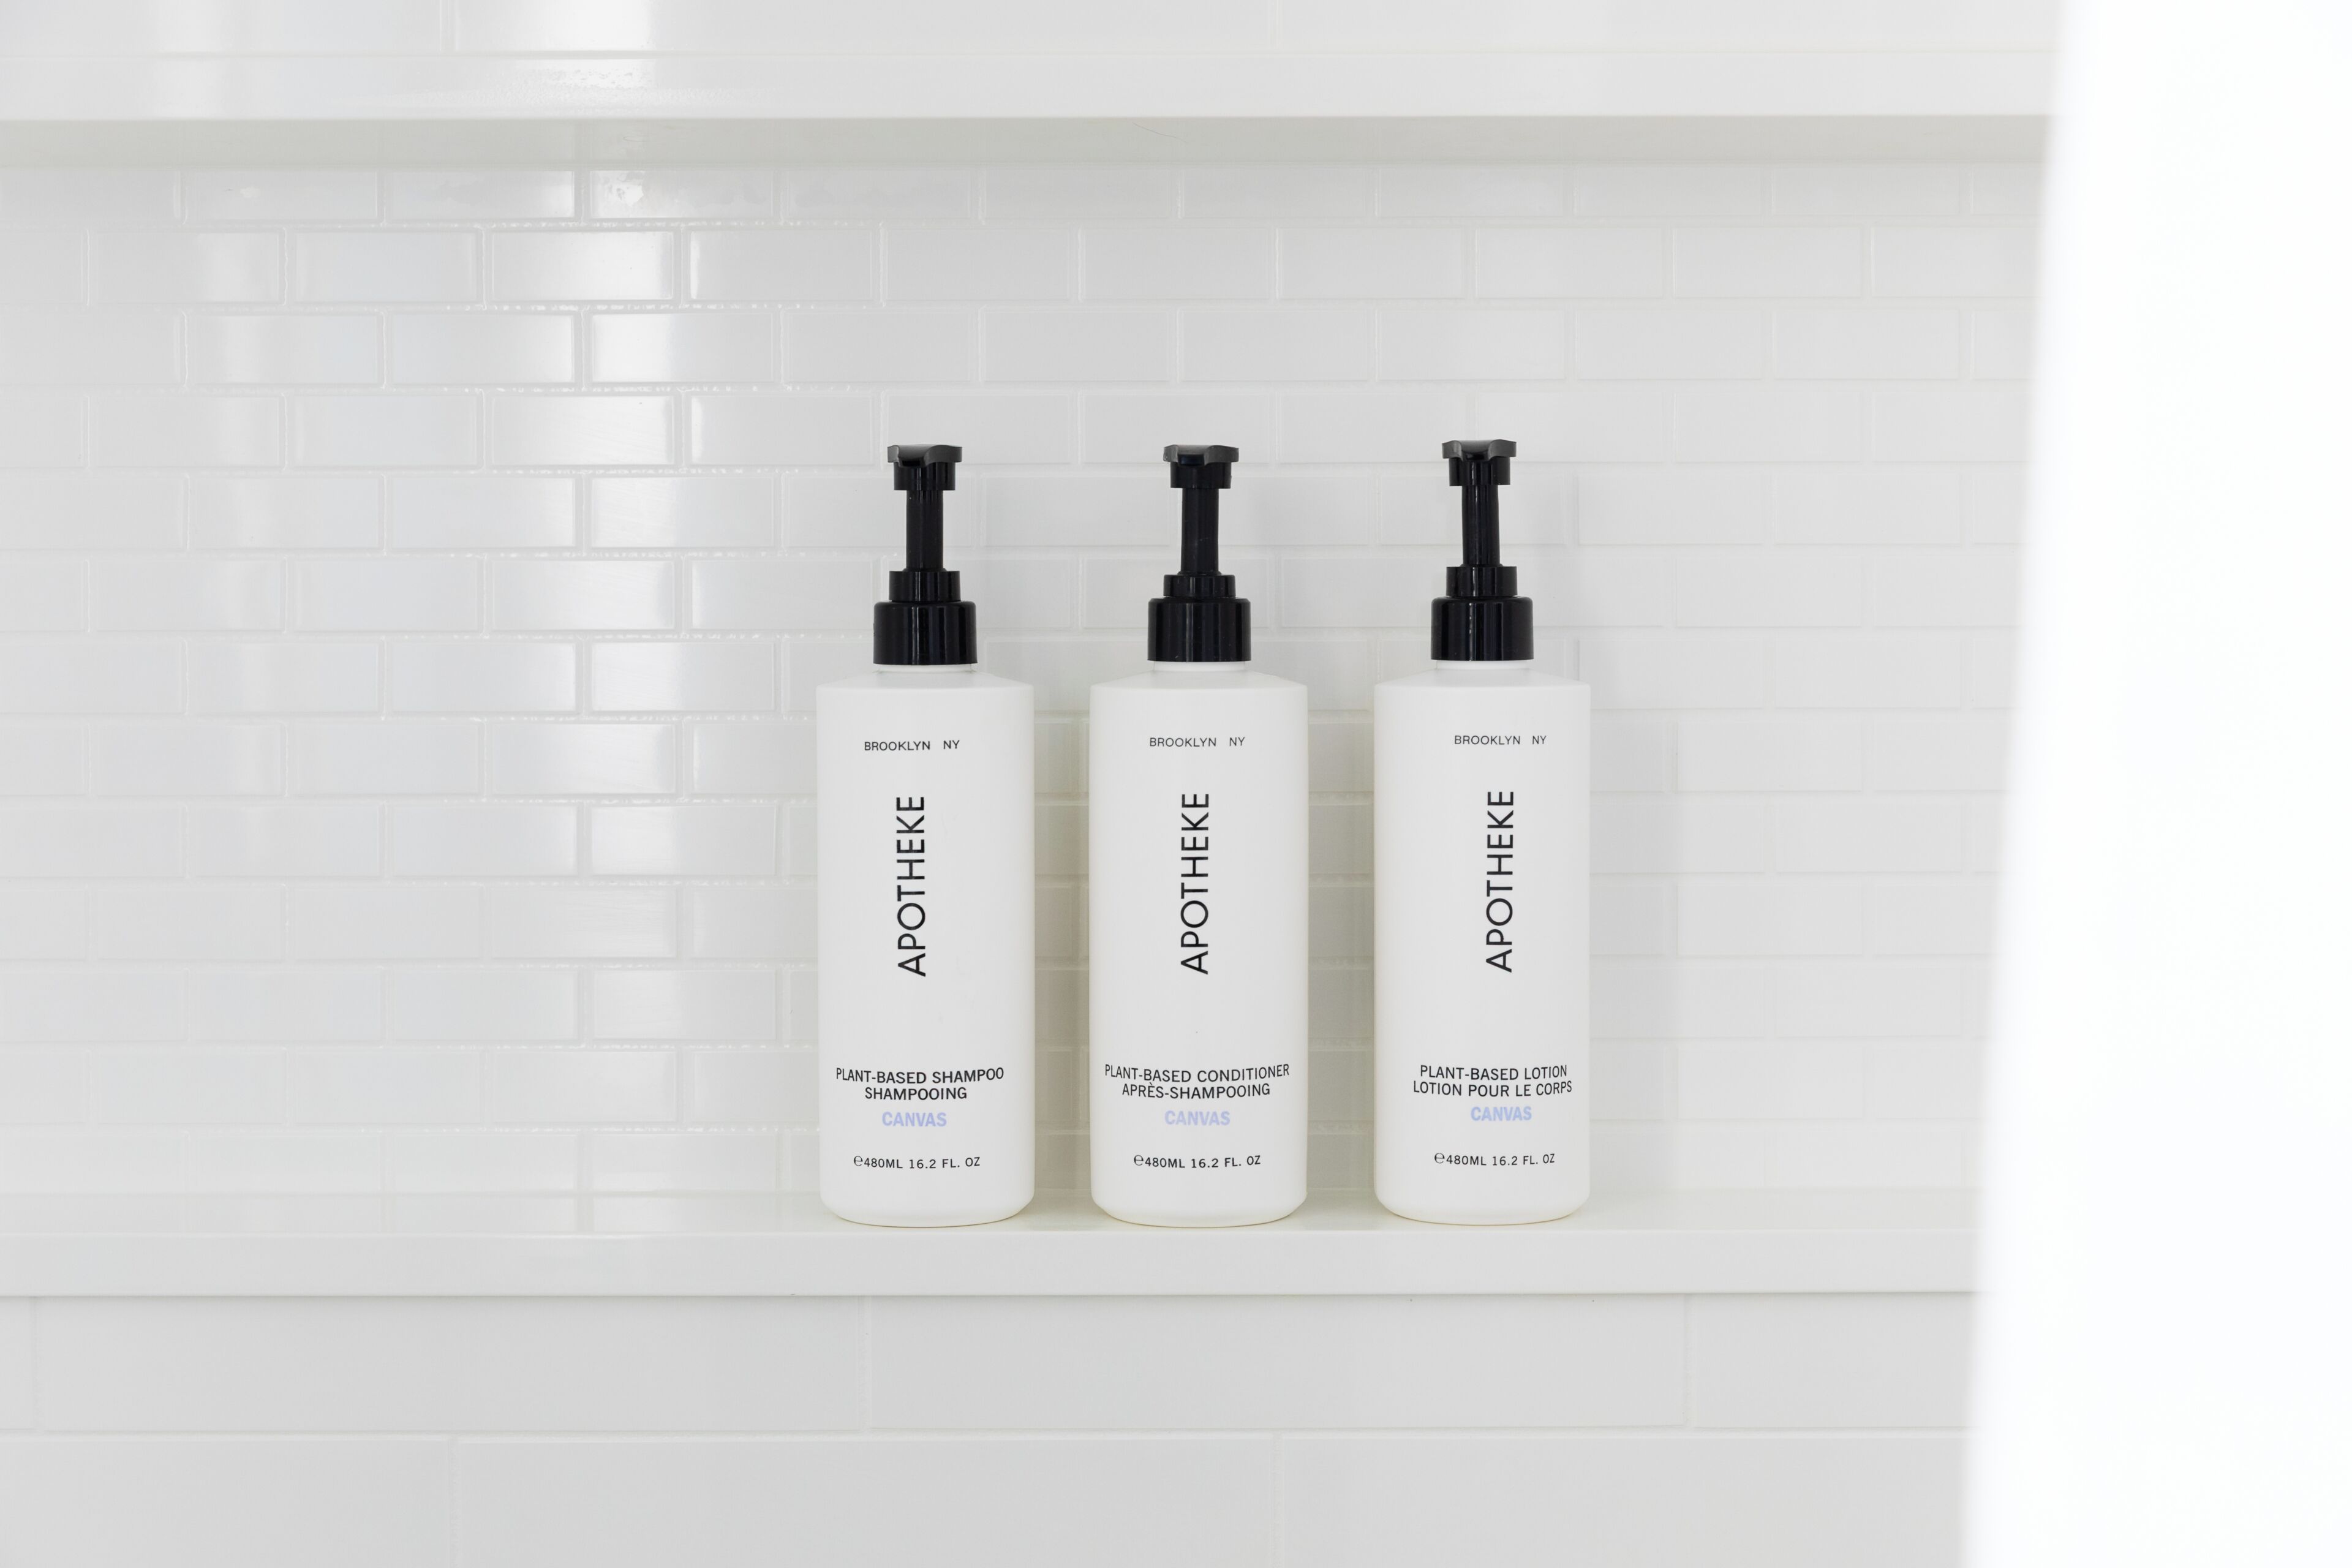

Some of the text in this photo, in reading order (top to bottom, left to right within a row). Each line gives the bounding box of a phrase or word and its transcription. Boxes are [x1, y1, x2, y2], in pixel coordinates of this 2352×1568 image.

[864, 739, 960, 751] BROOKLYN NY
[1149, 736, 1245, 747] BROOKLYN NY
[1454, 734, 1547, 745] BROOKLYN NY
[895, 796, 926, 978] APOTHEKE
[1180, 793, 1210, 975] APOTHEKE
[1485, 791, 1515, 973] APOTHEKE
[836, 1067, 1005, 1084] PLANT-BASED SHAMPOO
[1105, 1063, 1290, 1083] PLANT-BASED CONDITIONER
[1420, 1064, 1567, 1080] PLANT-BASED LOTION
[864, 1087, 967, 1101] SHAMPOOING
[1121, 1082, 1270, 1099] APRÈS-SHAMPOOING
[1413, 1080, 1572, 1098] LOTION POUR LE CORPS
[882, 1112, 948, 1127] CANVAS
[1165, 1110, 1231, 1126] CANVAS
[1471, 1106, 1532, 1121] CANVAS
[909, 1159, 937, 1169] 16.2
[941, 1158, 960, 1169] FL.
[965, 1156, 981, 1167] OZ
[1191, 1158, 1219, 1169] 16.2
[1224, 1157, 1242, 1167] FL.
[1246, 1155, 1261, 1166] OZ
[1492, 1156, 1518, 1166] 16.2
[1523, 1155, 1539, 1166] FL.
[1542, 1153, 1555, 1164] OZ
